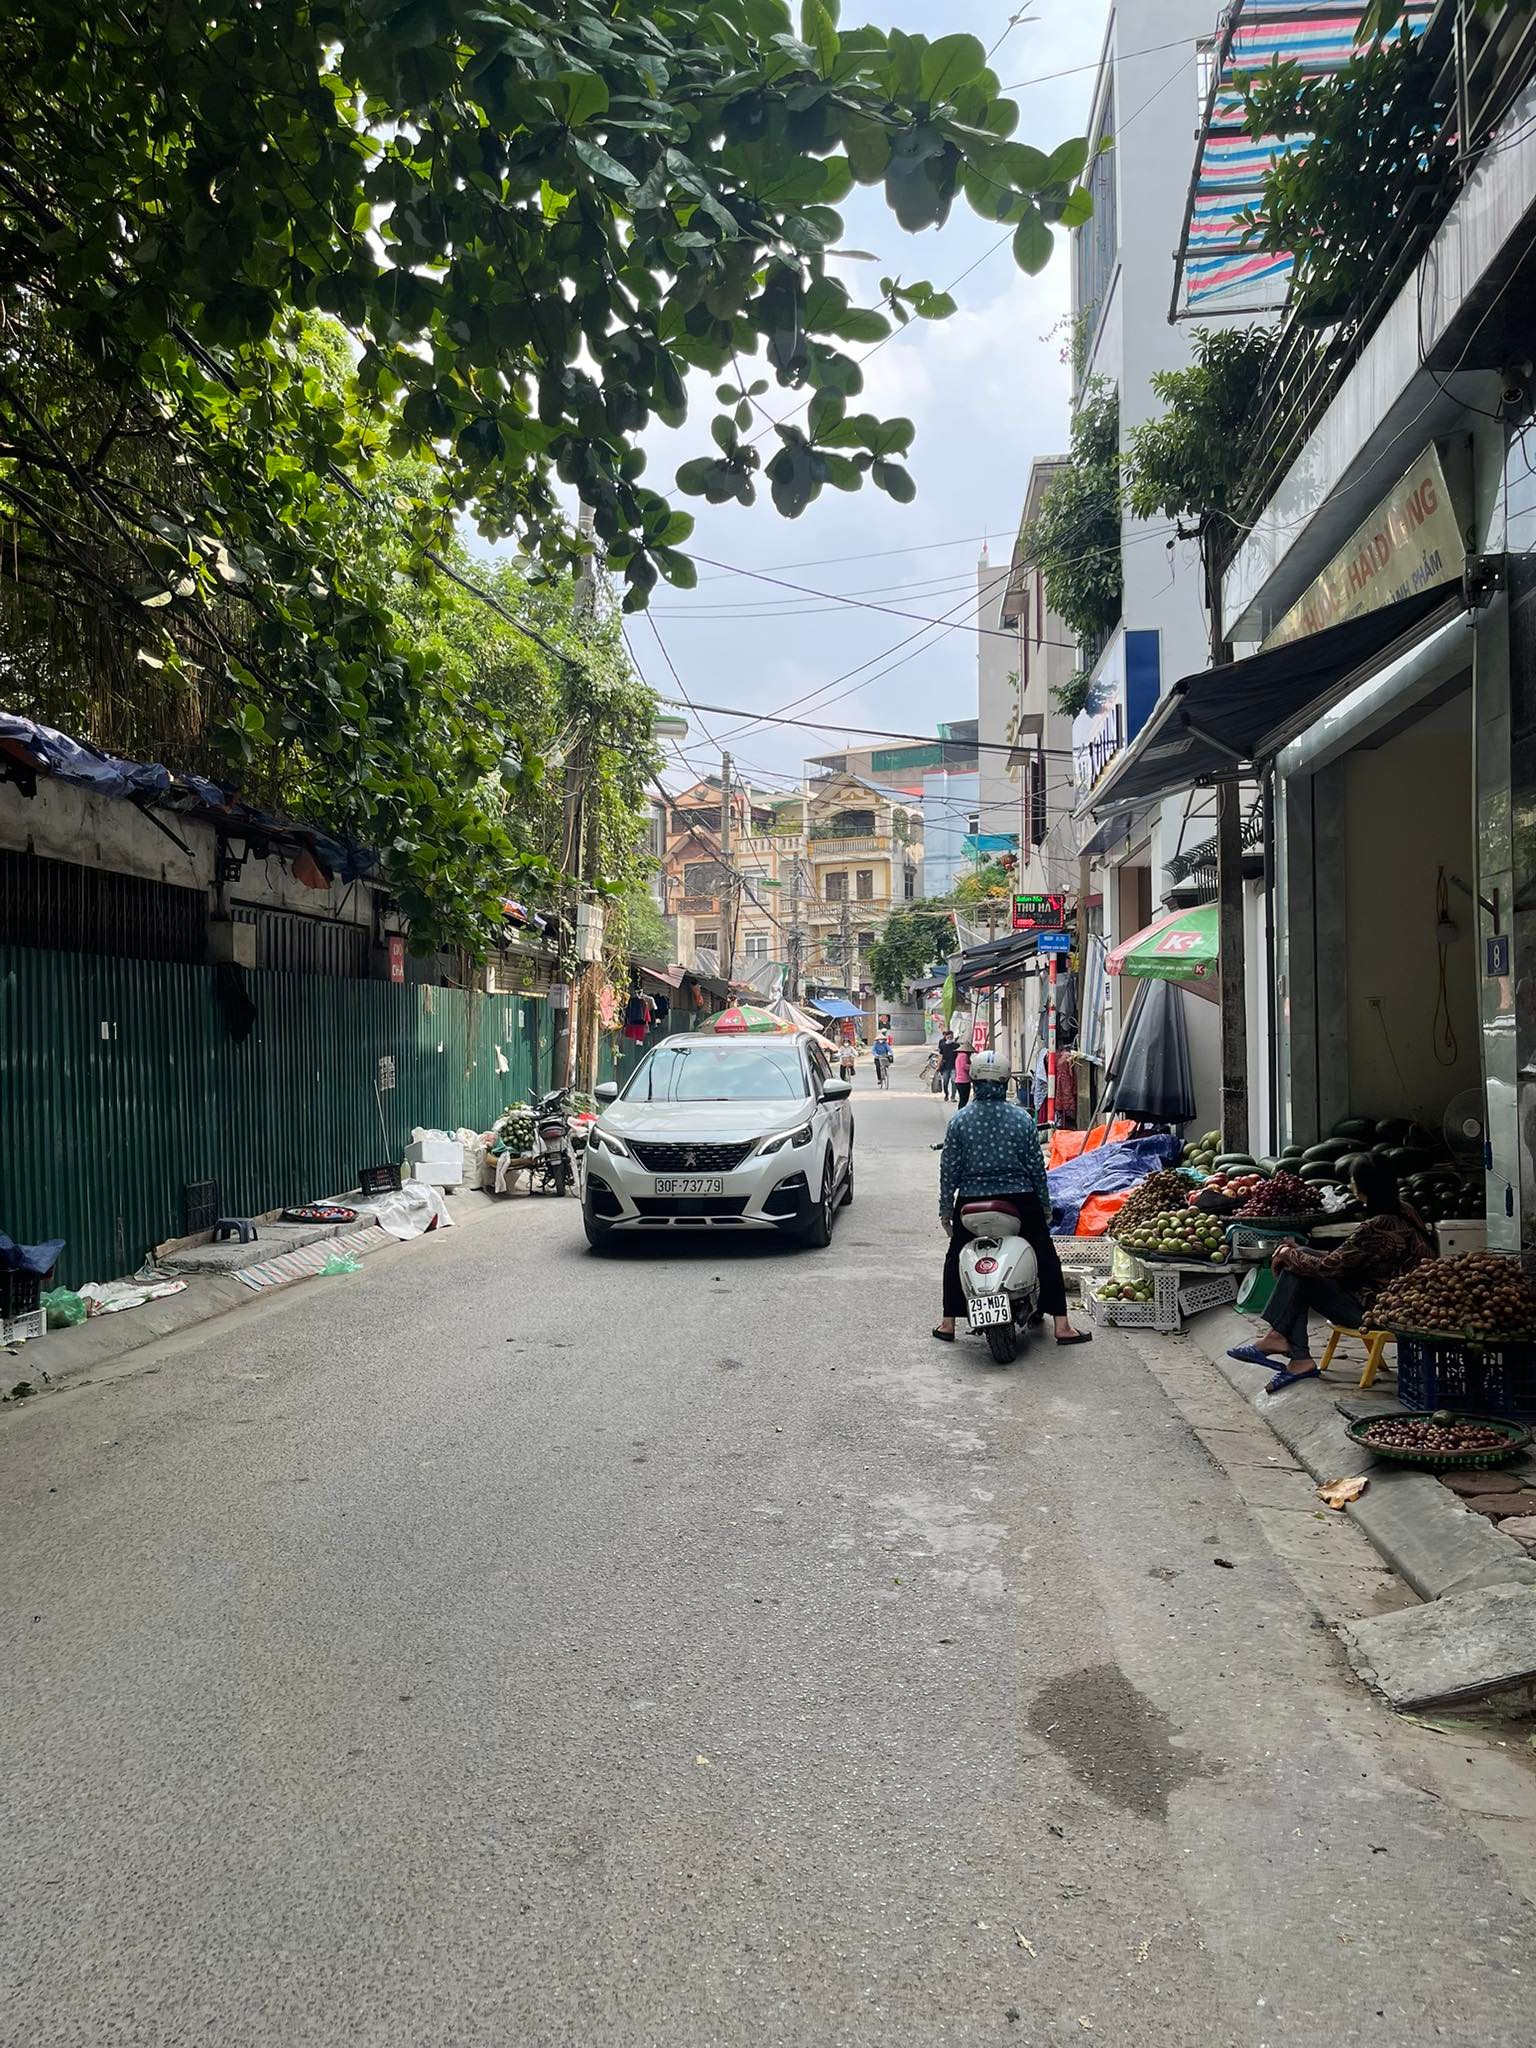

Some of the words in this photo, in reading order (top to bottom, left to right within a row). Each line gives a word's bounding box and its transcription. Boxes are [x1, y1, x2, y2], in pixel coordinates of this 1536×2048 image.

[1017, 903, 1035, 912] THU
[1163, 935, 1203, 950] K+
[1493, 944, 1500, 968] 8
[658, 1180, 720, 1192] 30F-737.79
[972, 1309, 1008, 1325] 130.79
